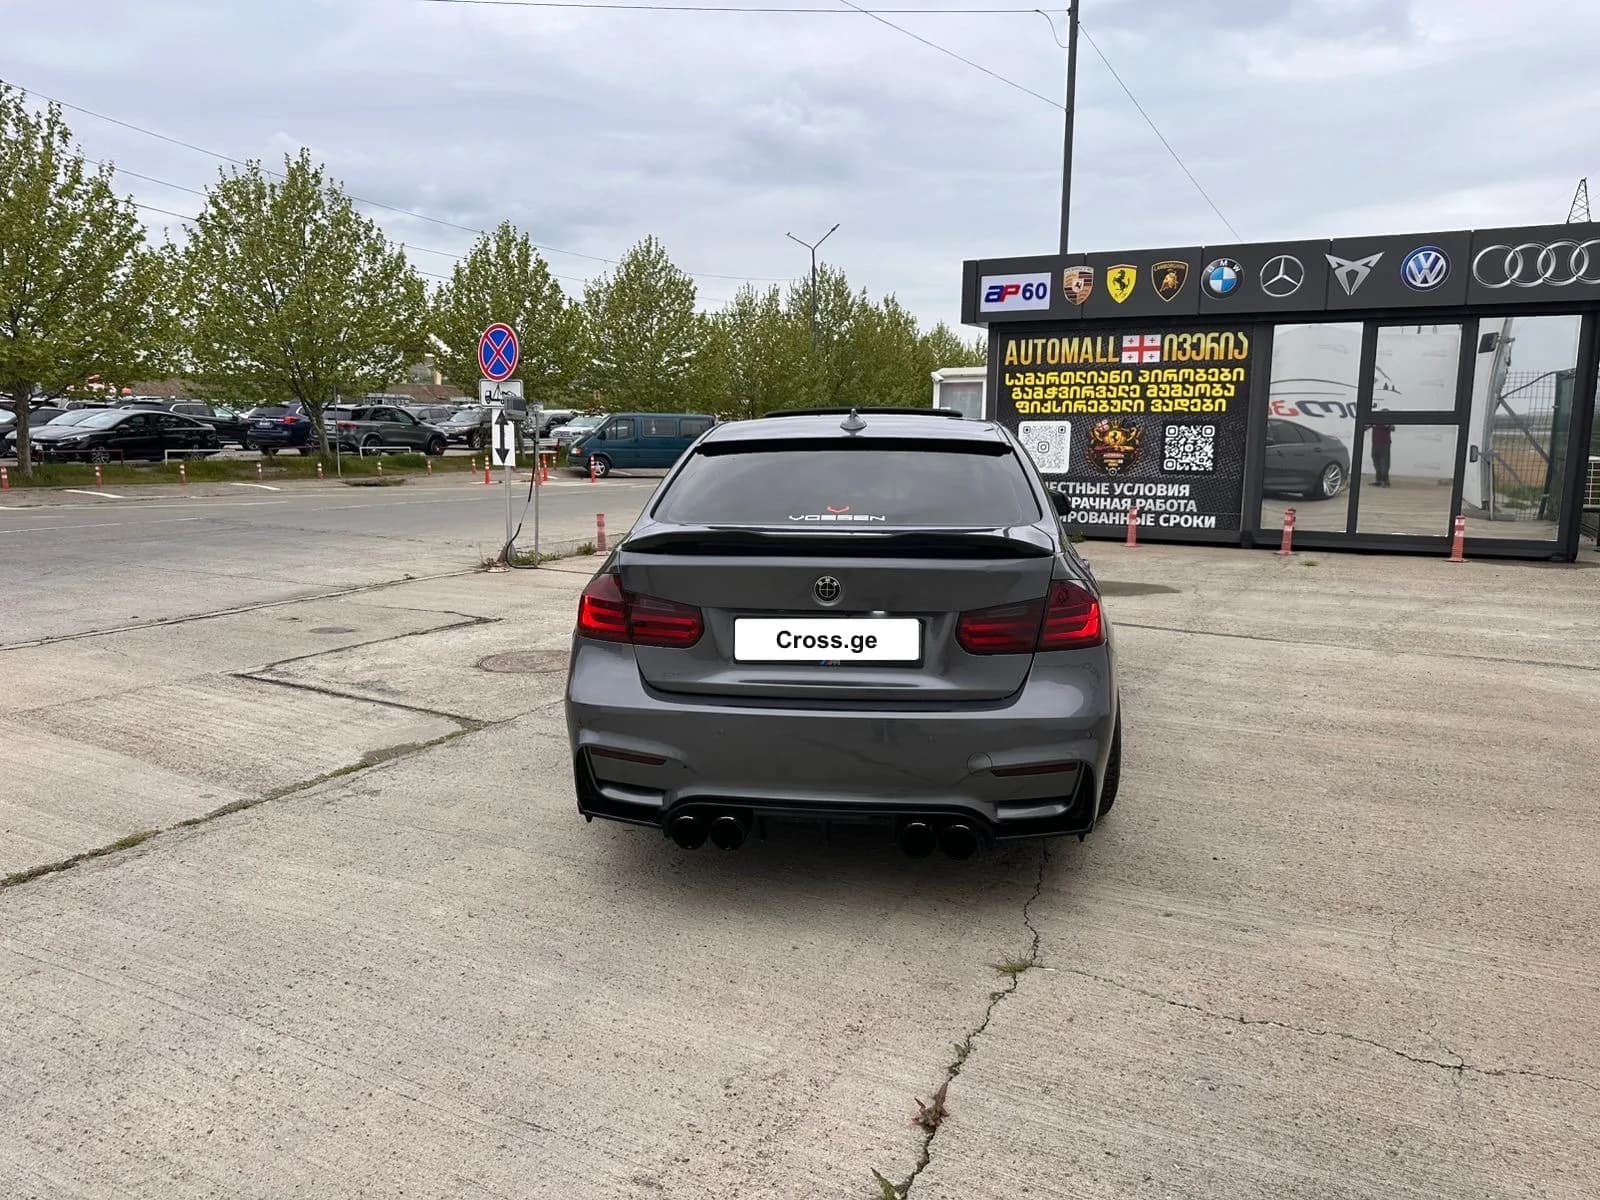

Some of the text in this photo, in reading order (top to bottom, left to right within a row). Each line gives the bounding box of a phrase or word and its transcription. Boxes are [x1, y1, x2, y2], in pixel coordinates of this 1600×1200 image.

[1004, 335, 1120, 366] AUTOMALL
[1162, 331, 1249, 361] ივერია
[1005, 367, 1245, 386] სამართლიანი პირობები
[1011, 383, 1236, 400] გამჭვირვალე მუშაობა
[1015, 398, 1227, 414] ფიქსირებული ვადები
[1046, 481, 1191, 497] ЕСТНЫЕ УСЛОВИЯ
[1069, 496, 1198, 513] РАЧНАЯ РАБОТА
[1059, 510, 1216, 529] ИРОВАННЫЕ СРОКИ
